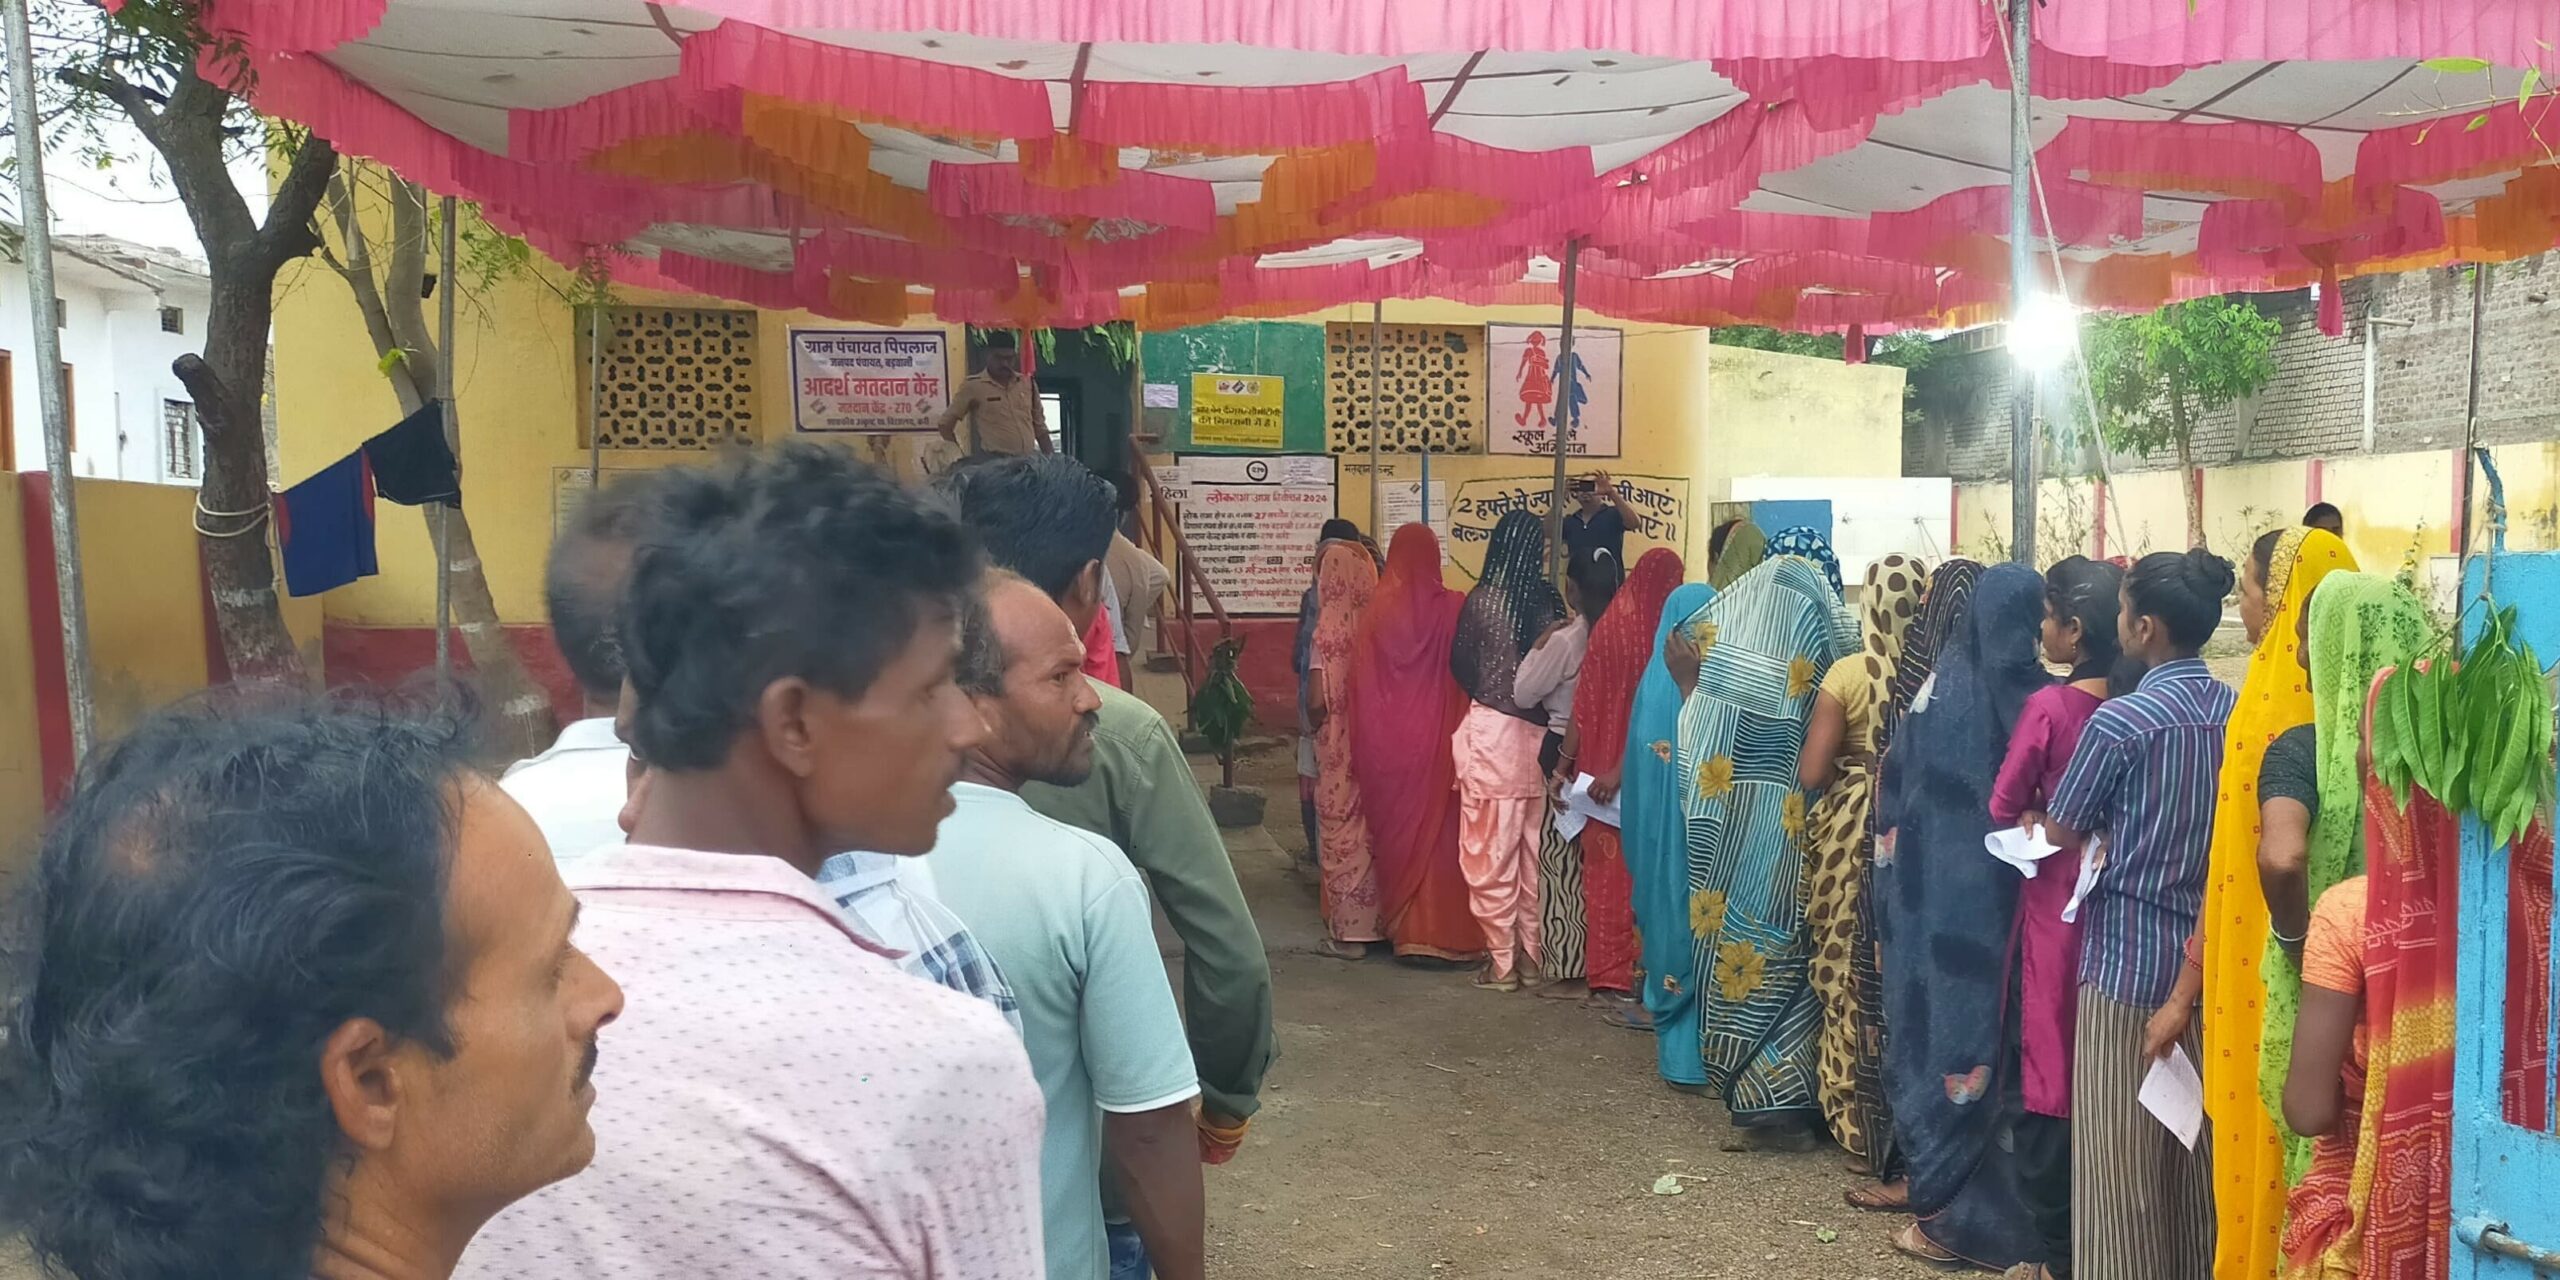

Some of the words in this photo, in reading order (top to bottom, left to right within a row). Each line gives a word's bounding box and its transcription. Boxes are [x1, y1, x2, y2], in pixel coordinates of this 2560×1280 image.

[804, 340, 833, 354] ग्राम
[836, 338, 882, 354] पंचायत
[884, 337, 937, 354] पिपलाज
[830, 358, 854, 367] जनपद
[885, 356, 913, 369] बड़वानी
[804, 372, 850, 396] आदर्श
[852, 377, 910, 396] मतदान
[912, 372, 939, 398] केंद्र
[838, 402, 869, 414] मतदान
[871, 400, 886, 414] केंद्र
[895, 402, 912, 414] 270
[1213, 416, 1251, 426] निगरानी
[1512, 430, 1545, 446] स्कूल
[1151, 486, 1188, 499] हिला
[1303, 494, 1328, 503] 2024
[1457, 498, 1472, 513] 2
[1476, 491, 1512, 520] हफ्ते
[1451, 522, 1495, 543] बलग
